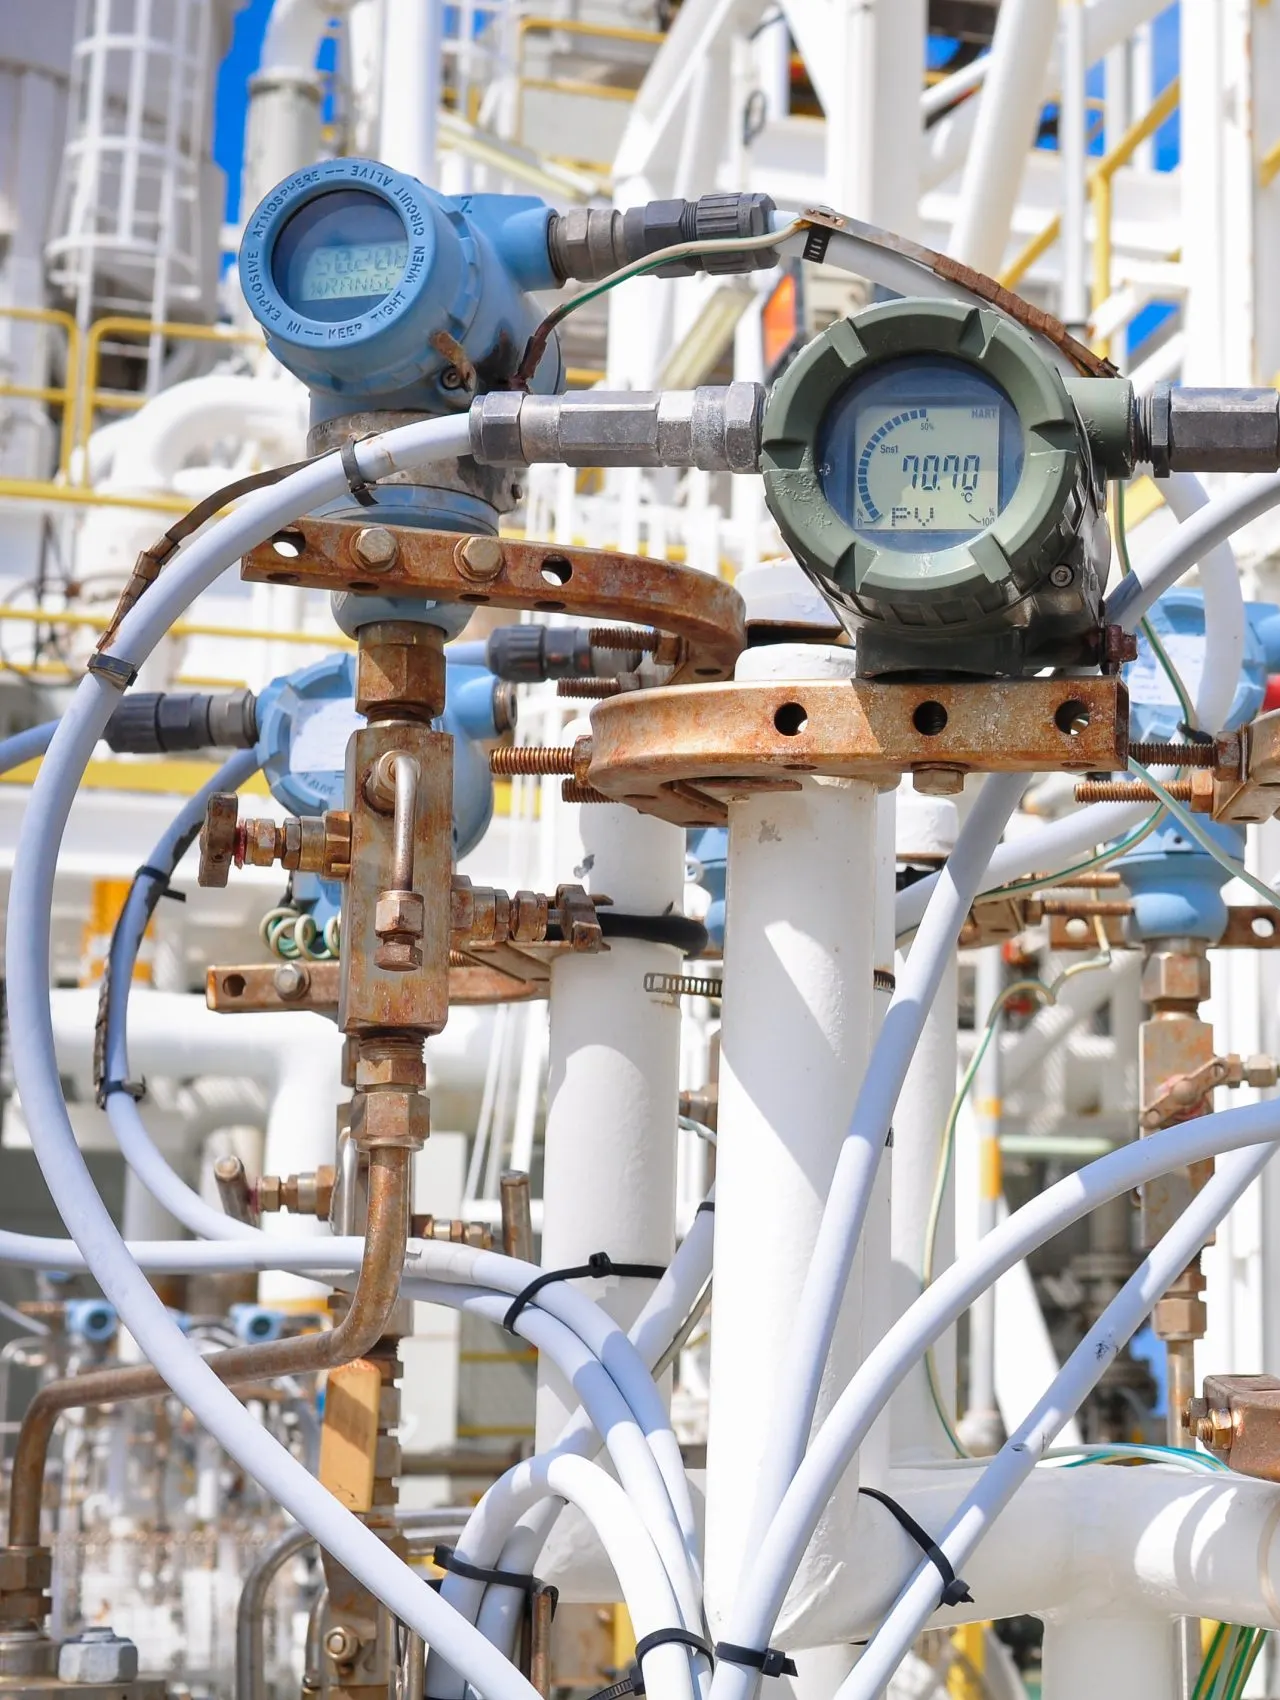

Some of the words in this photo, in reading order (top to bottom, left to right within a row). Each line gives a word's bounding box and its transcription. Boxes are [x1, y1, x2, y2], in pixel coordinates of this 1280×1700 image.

[350, 165, 393, 188] ALIVE
[252, 170, 321, 239] ATMOSPHERE
[393, 187, 425, 237] CIRCUIT
[404, 245, 425, 284] WHEN
[247, 251, 282, 321] EXPLOSIVE
[370, 290, 406, 321] TIGHT
[286, 319, 302, 335] IN
[327, 322, 363, 340] KEEP
[920, 422, 935, 431] 50%
[971, 408, 997, 419] HART
[902, 454, 980, 491] 70.70
[891, 507, 934, 526] PV
